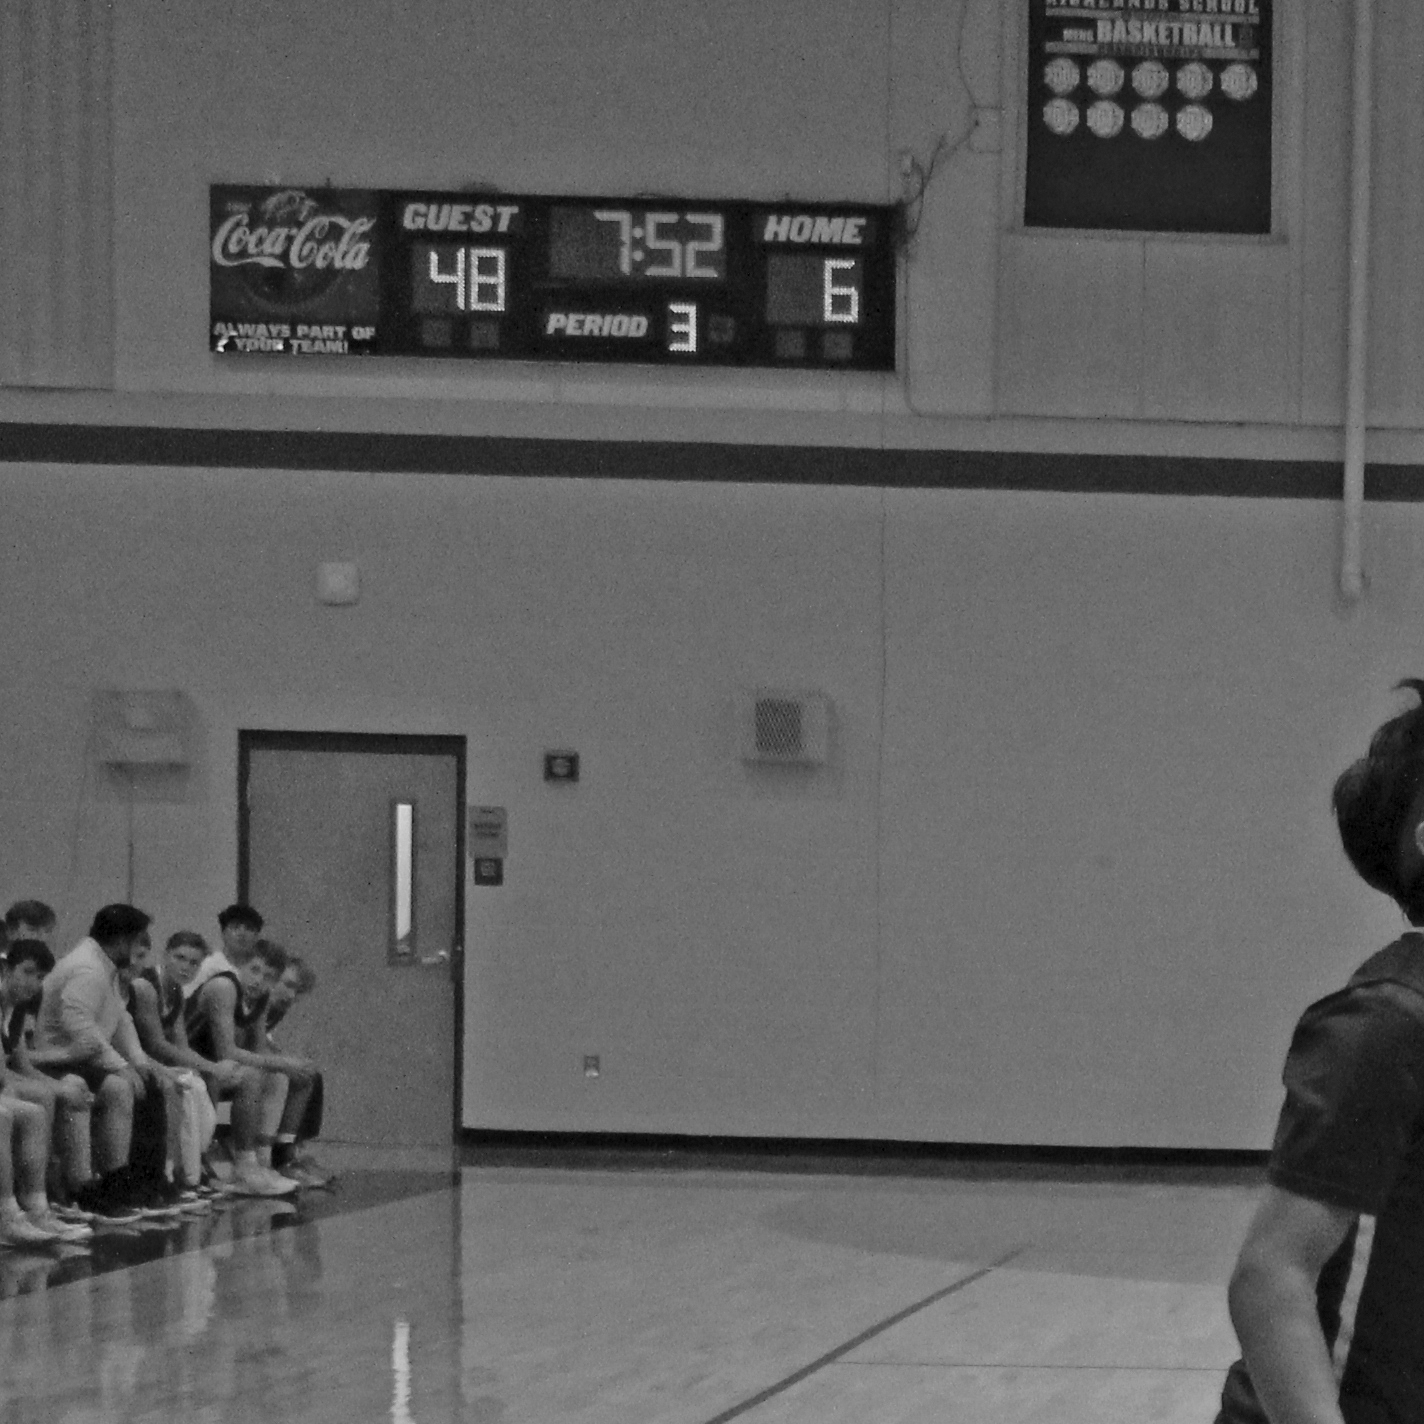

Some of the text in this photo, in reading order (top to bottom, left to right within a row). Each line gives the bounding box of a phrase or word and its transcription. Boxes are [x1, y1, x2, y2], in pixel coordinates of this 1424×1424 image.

[1096, 19, 1235, 48] BASKETBALL
[403, 203, 519, 234] GUEST
[764, 215, 868, 246] HOME
[212, 213, 376, 272] Coca-Cola
[594, 210, 726, 279] 7:52
[429, 247, 507, 312] 48
[822, 259, 860, 324] 6
[213, 322, 376, 340] ALWAYS PART OF
[546, 312, 650, 340] PERIOD
[668, 303, 699, 353] 3
[234, 337, 284, 353] YOUR
